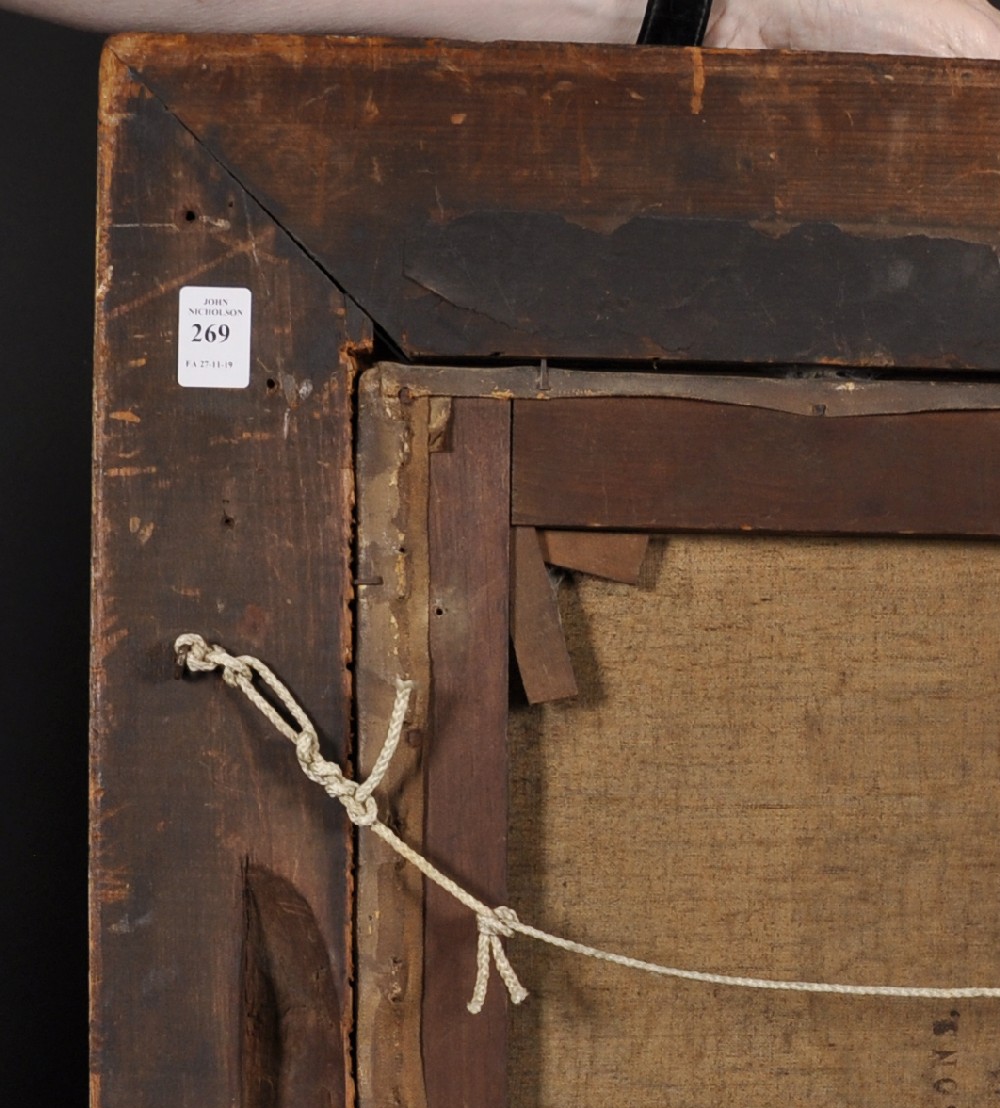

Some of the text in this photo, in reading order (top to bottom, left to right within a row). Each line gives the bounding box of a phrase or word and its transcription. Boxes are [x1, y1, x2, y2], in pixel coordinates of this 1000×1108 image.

[203, 298, 228, 306] JOHN
[188, 308, 243, 316] NICHOLSON
[191, 323, 230, 343] 269
